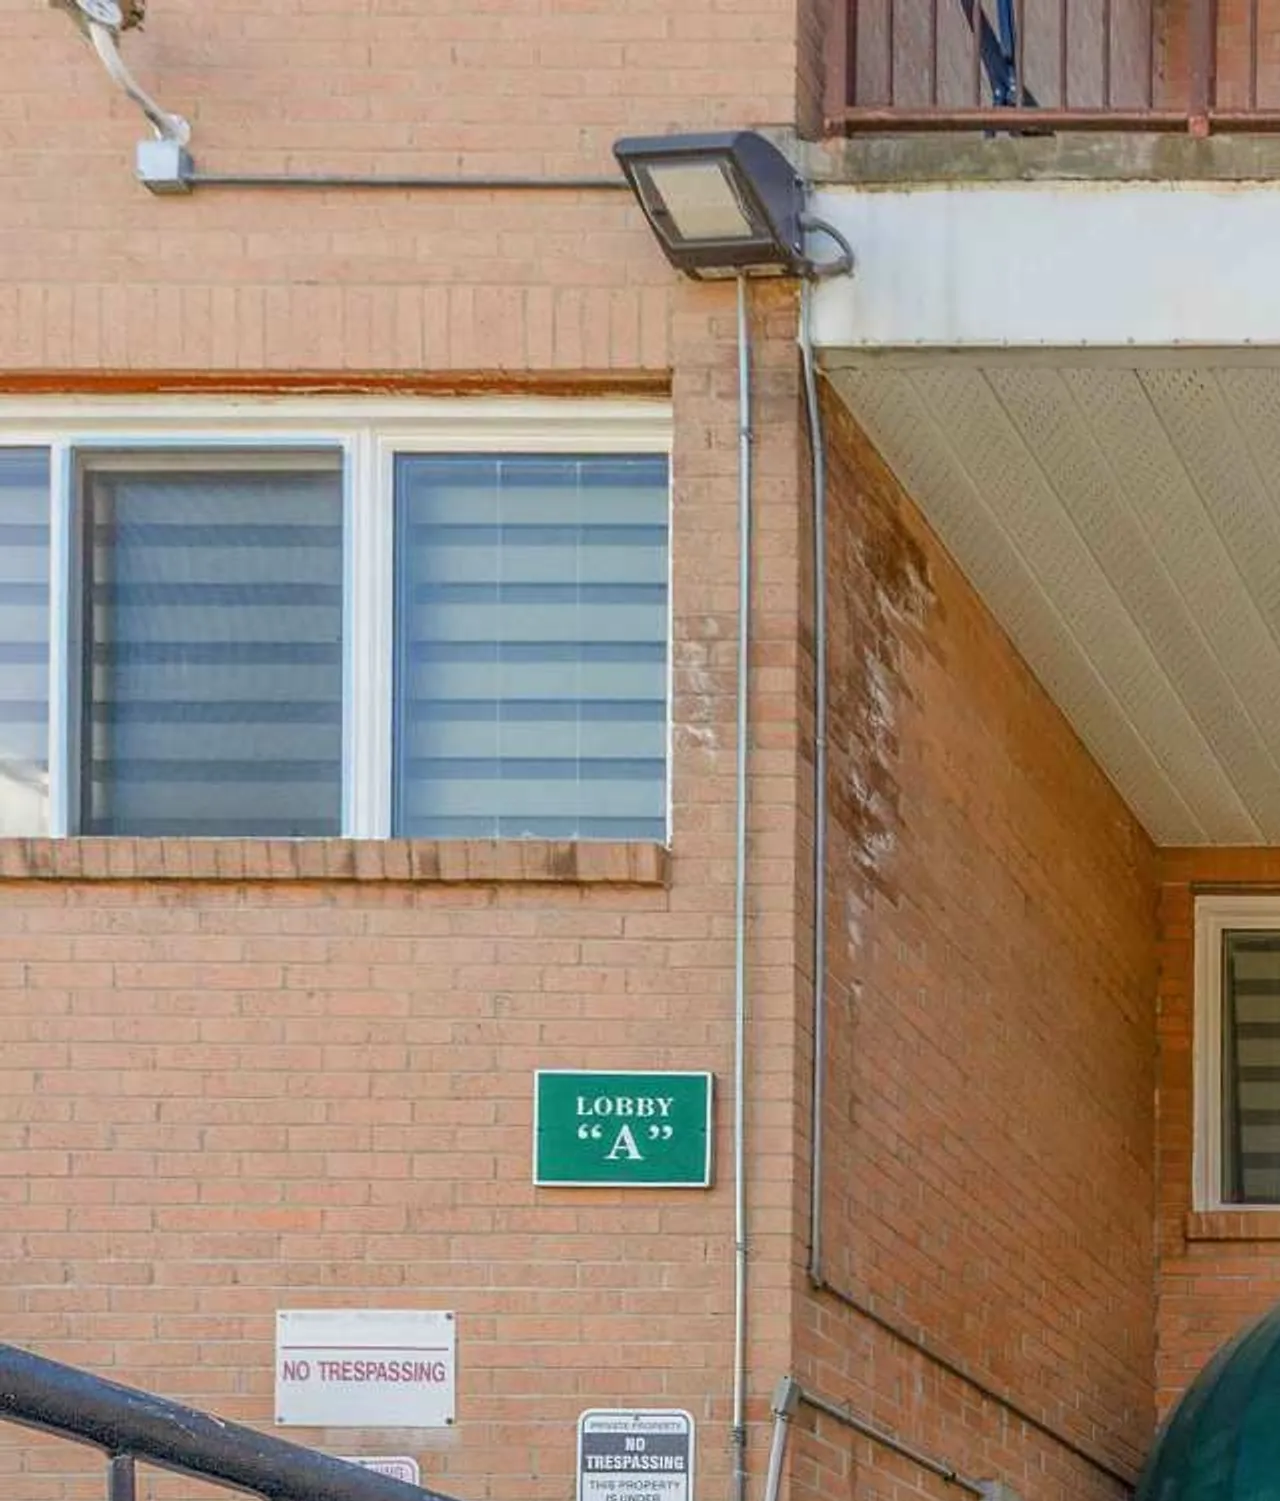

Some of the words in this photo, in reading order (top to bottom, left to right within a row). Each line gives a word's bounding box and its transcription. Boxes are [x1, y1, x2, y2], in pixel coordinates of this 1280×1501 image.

[576, 1096, 674, 1117] LOBBY
[283, 1361, 310, 1382] NO
[318, 1361, 446, 1383] TRESPASSING
[624, 1436, 646, 1452] NO
[584, 1455, 685, 1470] TRESPASSING
[589, 1480, 616, 1491] THIS
[618, 1480, 681, 1491] PROPERTY
